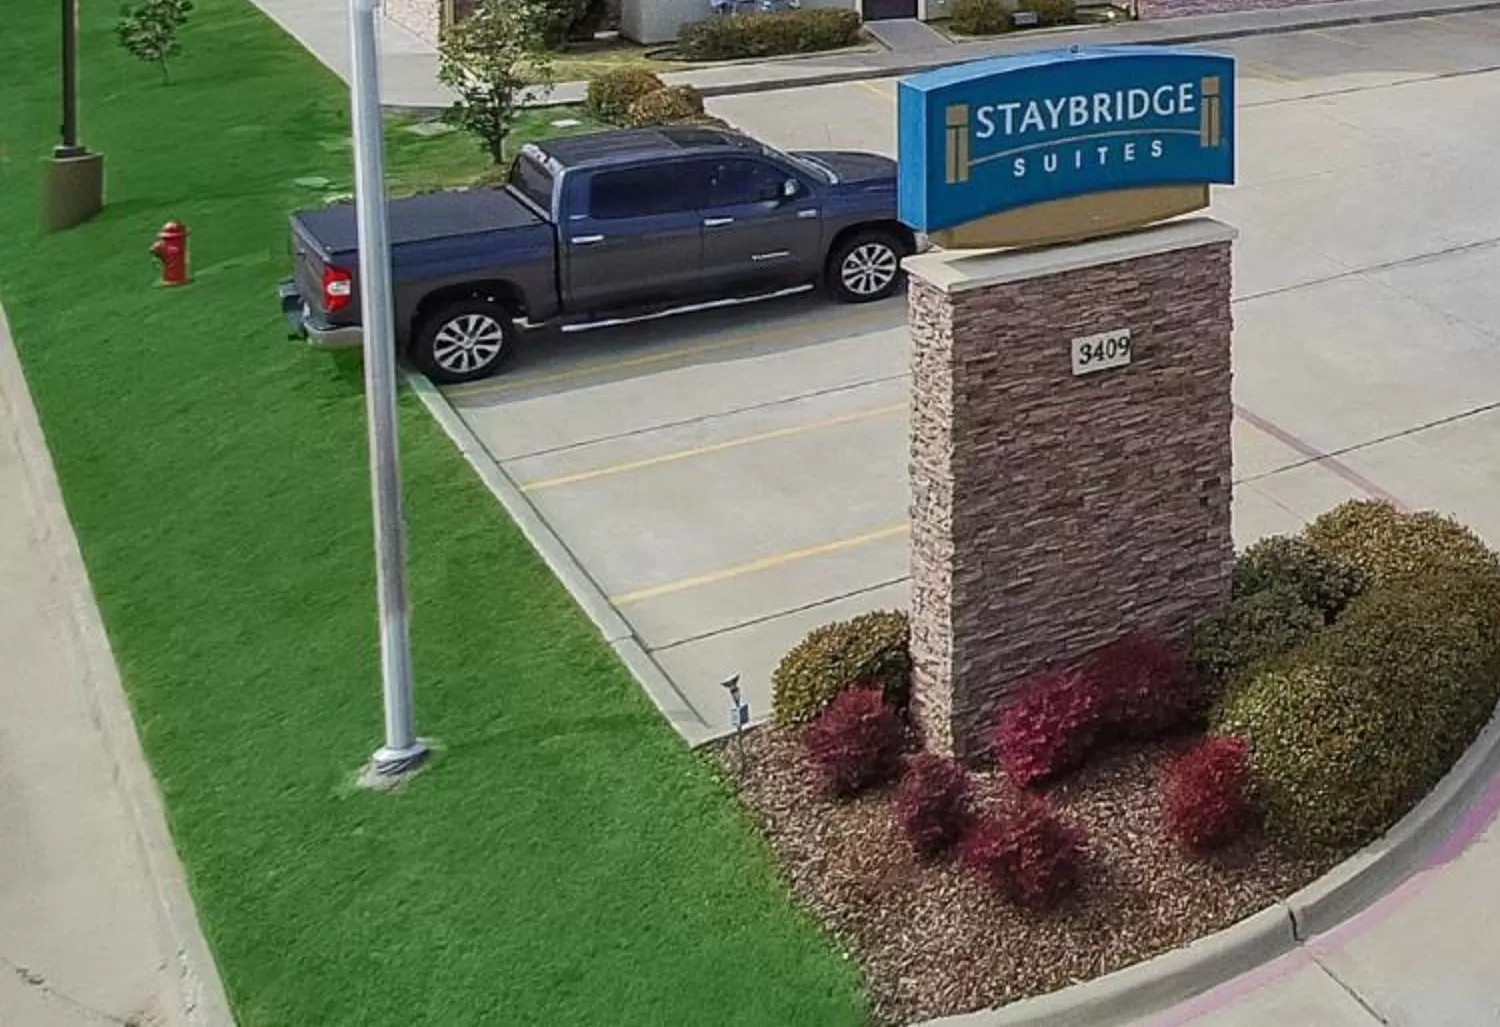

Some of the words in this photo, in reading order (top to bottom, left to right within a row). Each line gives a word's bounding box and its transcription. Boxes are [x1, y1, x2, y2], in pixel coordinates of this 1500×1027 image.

[975, 82, 1196, 139] STAYBRIDGE
[1013, 140, 1164, 178] SUITES
[1079, 336, 1131, 366] 3409
